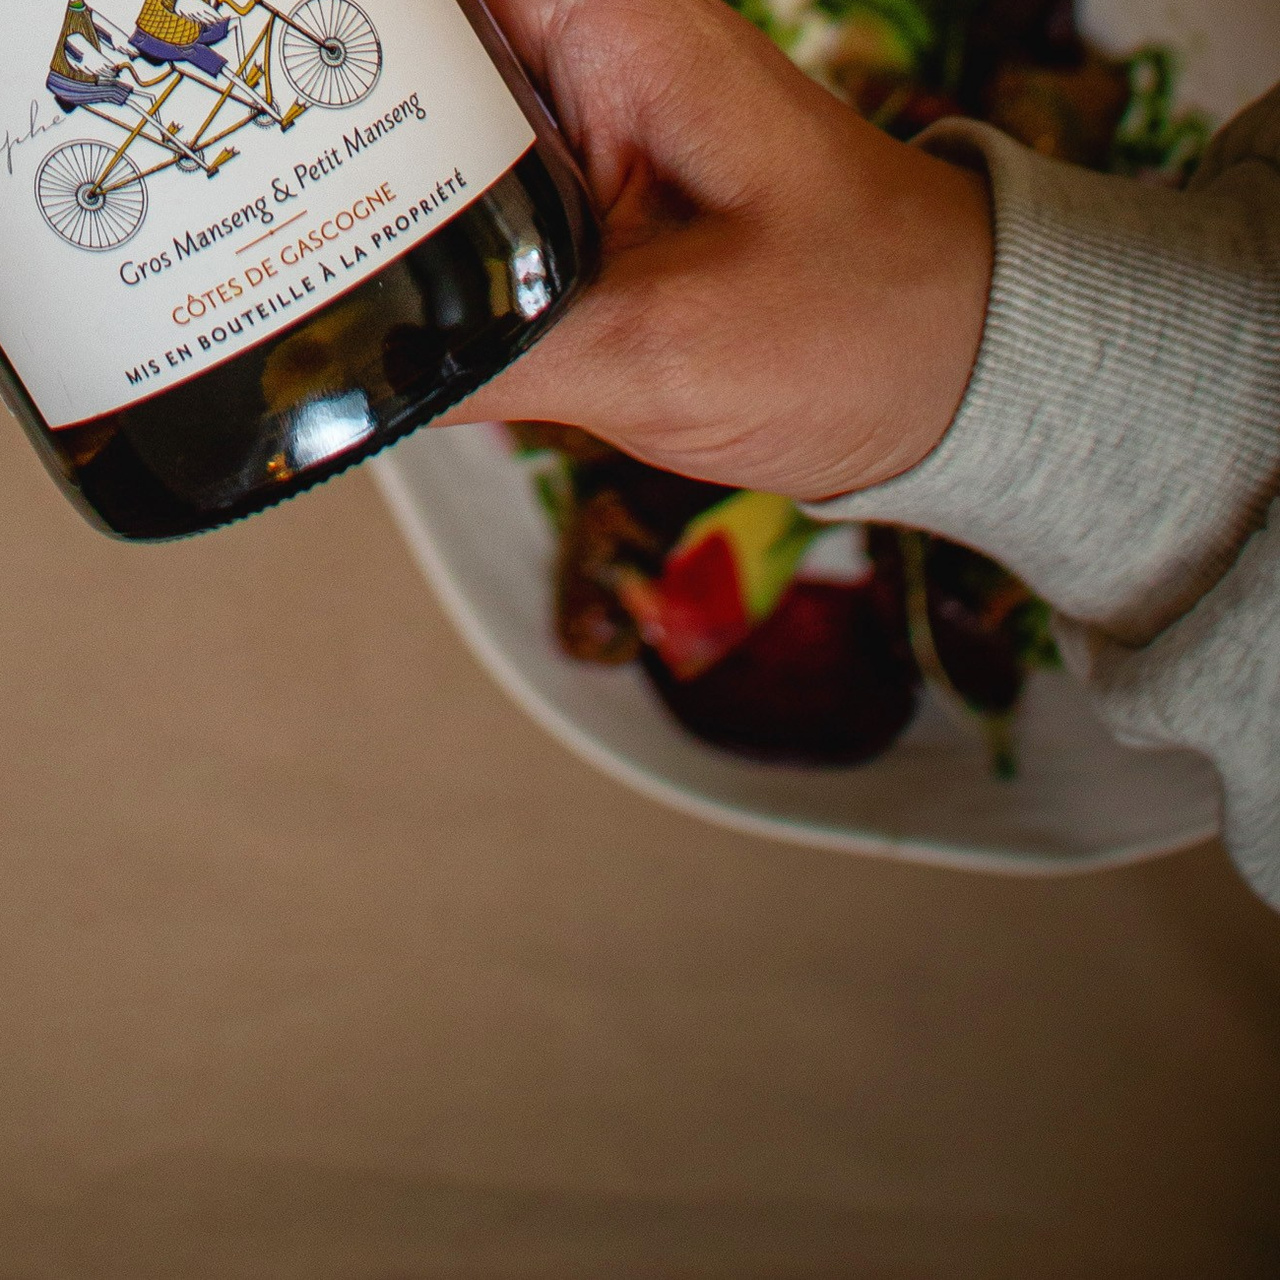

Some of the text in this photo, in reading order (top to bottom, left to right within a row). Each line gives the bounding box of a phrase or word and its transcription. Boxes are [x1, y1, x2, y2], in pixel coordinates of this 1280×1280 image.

[120, 92, 426, 285] Gros Manseng & Petit Manseng
[125, 167, 468, 385] MIS EN BOUTEILLE À LA PROPRIÉTÉ
[172, 182, 397, 325] CÔTES DE GASCOGNE
